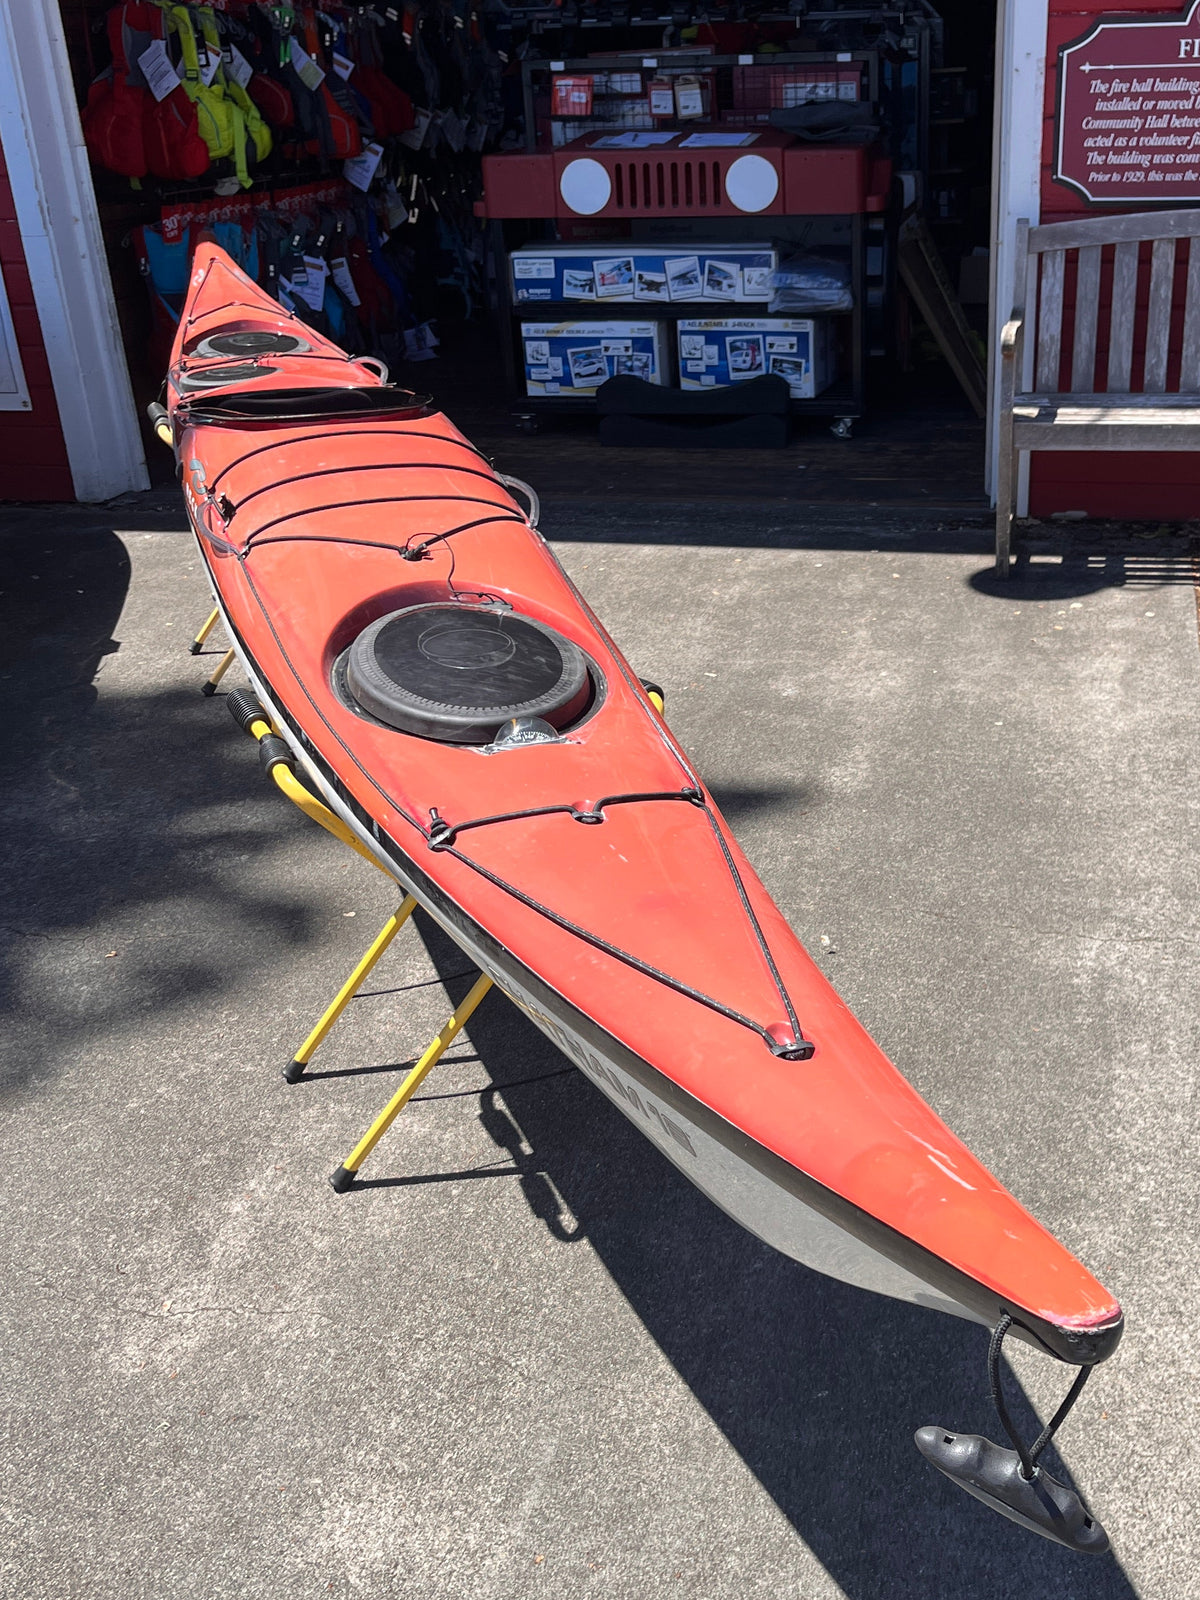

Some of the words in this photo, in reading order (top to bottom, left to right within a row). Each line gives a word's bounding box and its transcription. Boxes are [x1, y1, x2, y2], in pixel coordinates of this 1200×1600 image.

[1090, 79, 1109, 93] The
[1107, 78, 1130, 97] fire
[1131, 78, 1153, 92] hall
[1095, 97, 1142, 111] installed
[1142, 100, 1156, 110] or
[1157, 96, 1195, 110] moved
[1082, 116, 1144, 132] Community
[1145, 114, 1170, 128] Hall
[1083, 133, 1115, 147] acted
[1114, 136, 1128, 147] as
[1129, 136, 1138, 147] a
[1139, 132, 1190, 147] volunteer
[1087, 151, 1106, 165] The
[1107, 150, 1152, 168] building
[1153, 153, 1175, 164] was
[1088, 171, 1111, 182] Prior
[1111, 172, 1121, 182] to
[1147, 169, 1164, 182] this
[1165, 172, 1184, 182] was
[1184, 169, 1199, 181] the
